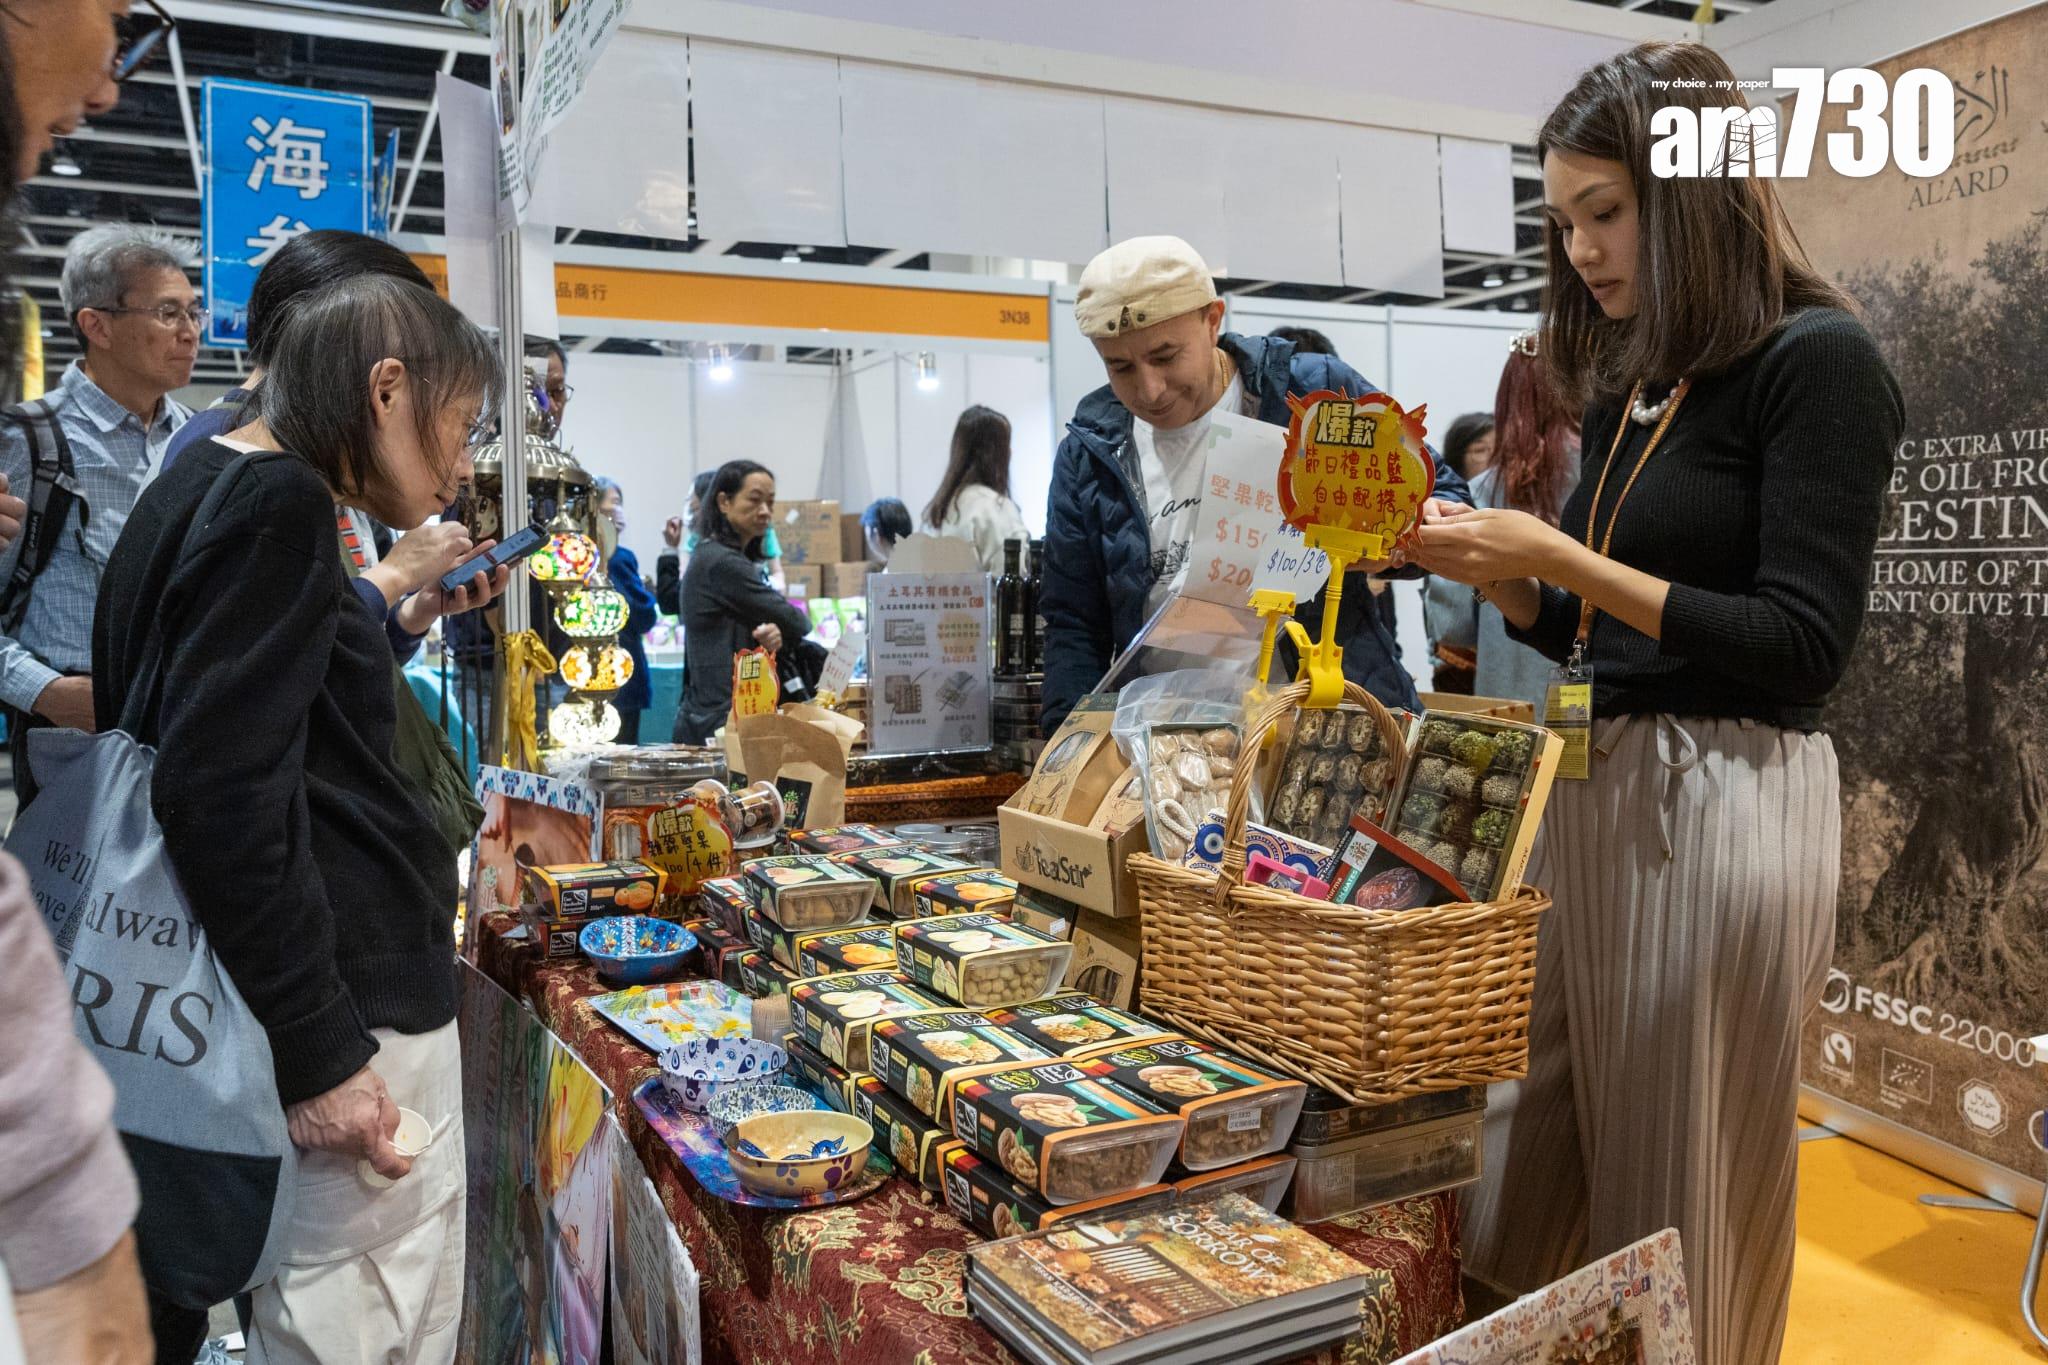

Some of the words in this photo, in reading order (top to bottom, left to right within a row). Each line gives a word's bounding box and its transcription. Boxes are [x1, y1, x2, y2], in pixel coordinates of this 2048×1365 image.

[1315, 400, 1377, 448] 爆款
[1923, 433, 2003, 458] EXTRA
[1211, 474, 1282, 515] 堅果乾
[1920, 462, 1982, 492] OIL
[1216, 517, 1268, 549] $15
[1872, 560, 1967, 585] HOME
[1977, 559, 2019, 586] OF
[1867, 591, 1924, 613] ENT
[1929, 591, 2013, 615] OLIVE
[43, 840, 92, 885] We'll
[1855, 985, 1933, 1034] FSSC
[1939, 1013, 2035, 1068] 22000
[1158, 1214, 1276, 1279] SORROW
[1201, 1214, 1253, 1249] YEAR
[1250, 1248, 1287, 1267] OF
